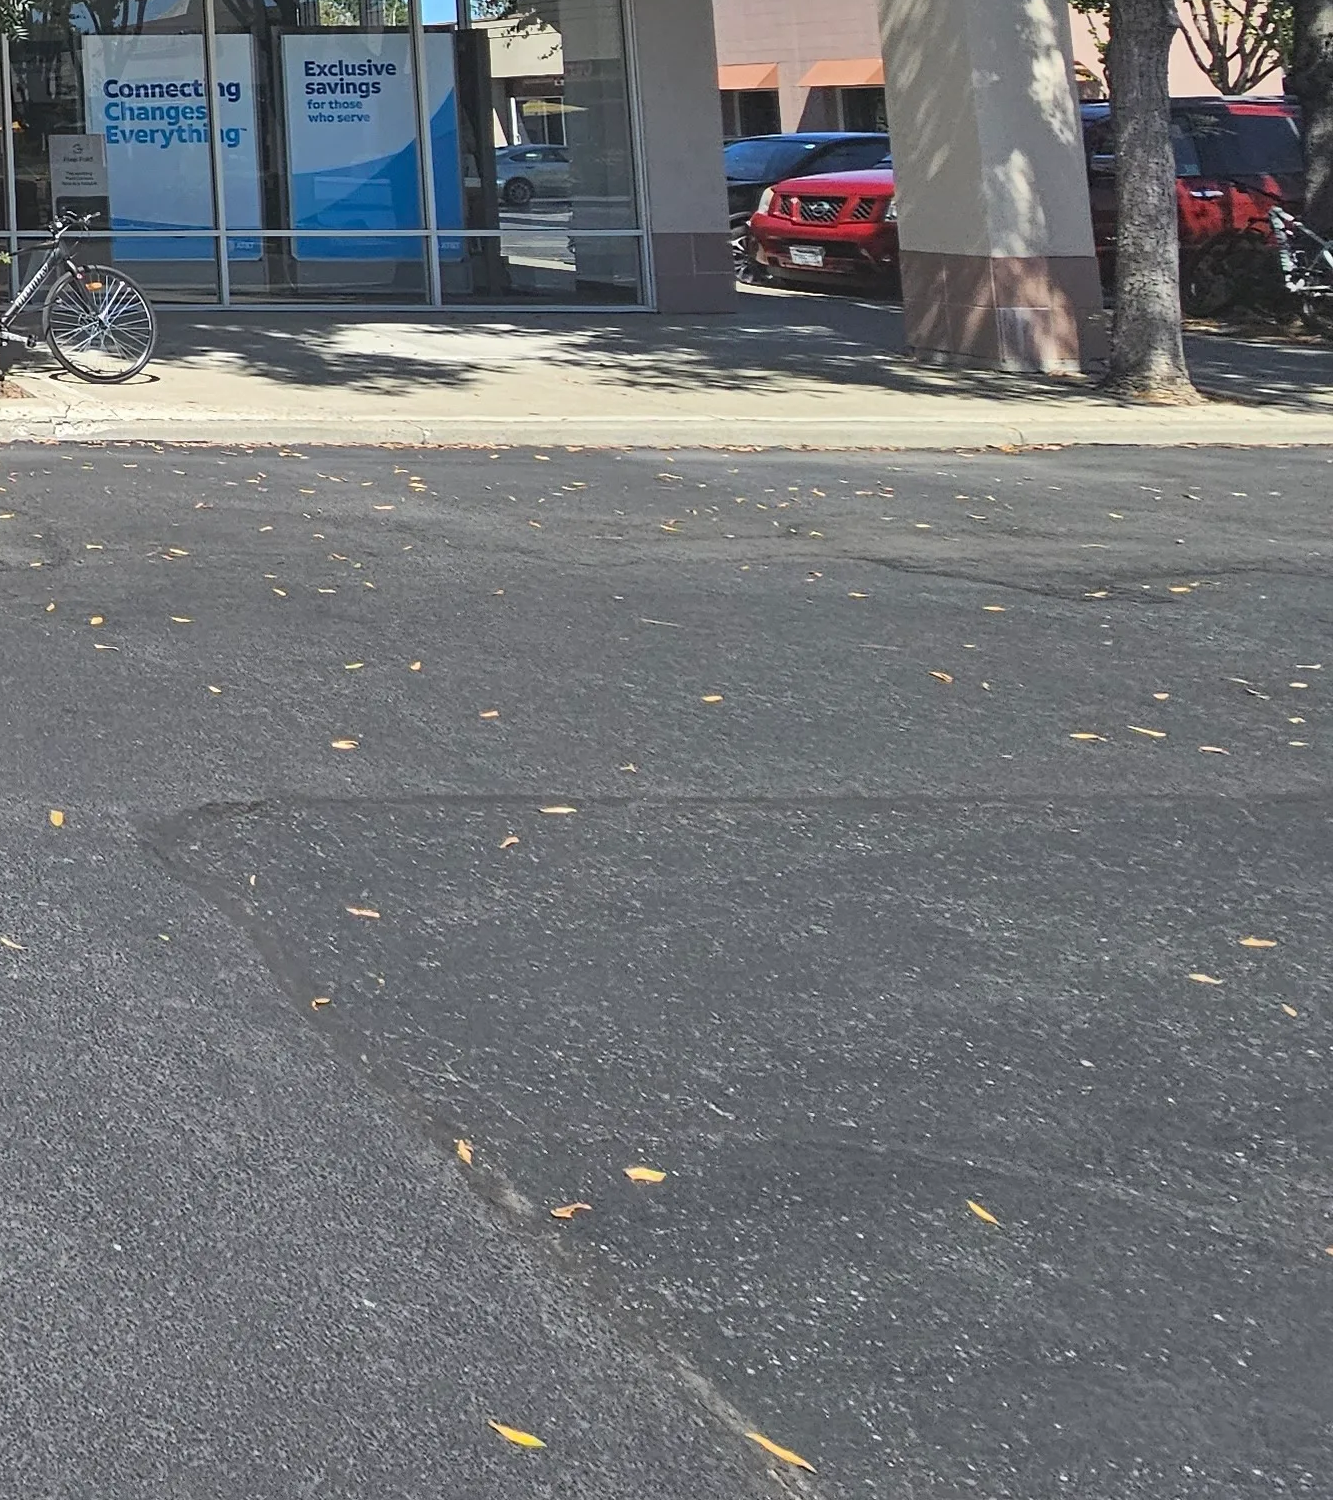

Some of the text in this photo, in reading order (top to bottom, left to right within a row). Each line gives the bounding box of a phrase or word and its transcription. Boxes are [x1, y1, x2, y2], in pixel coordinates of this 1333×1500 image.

[304, 58, 397, 77] Exclusive
[305, 77, 382, 99] savings
[104, 101, 208, 126] Changes
[307, 99, 363, 110] for those
[308, 112, 371, 123] who serve
